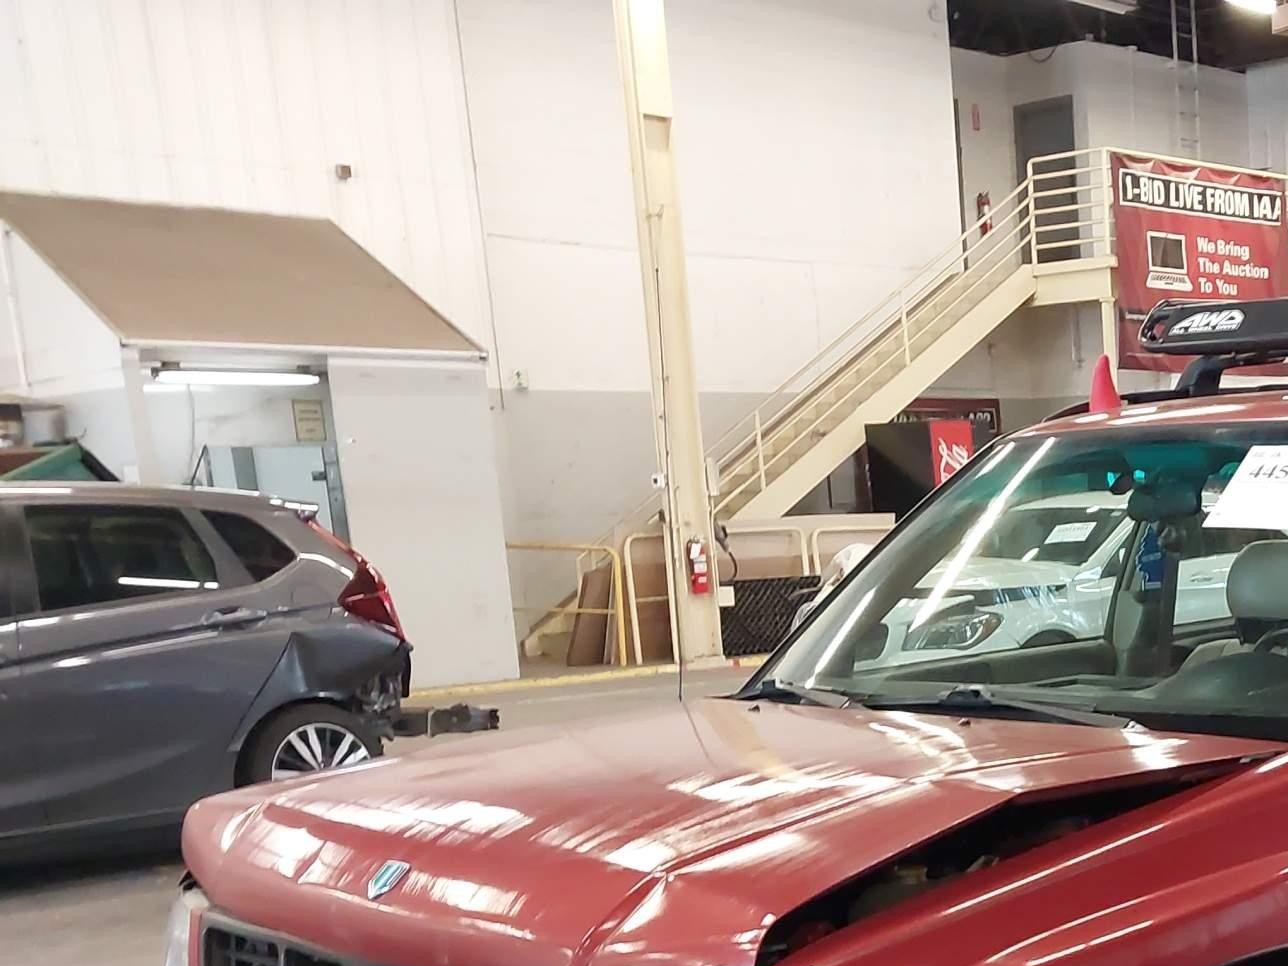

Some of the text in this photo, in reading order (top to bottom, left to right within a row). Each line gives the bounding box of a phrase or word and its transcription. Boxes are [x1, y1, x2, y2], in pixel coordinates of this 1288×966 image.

[1170, 182, 1203, 210] LIVE
[1206, 186, 1250, 217] FROM
[1196, 236, 1250, 259] We Bring
[1197, 257, 1269, 278] The Auction
[1198, 277, 1239, 296] To You
[1173, 309, 1246, 329] AWD
